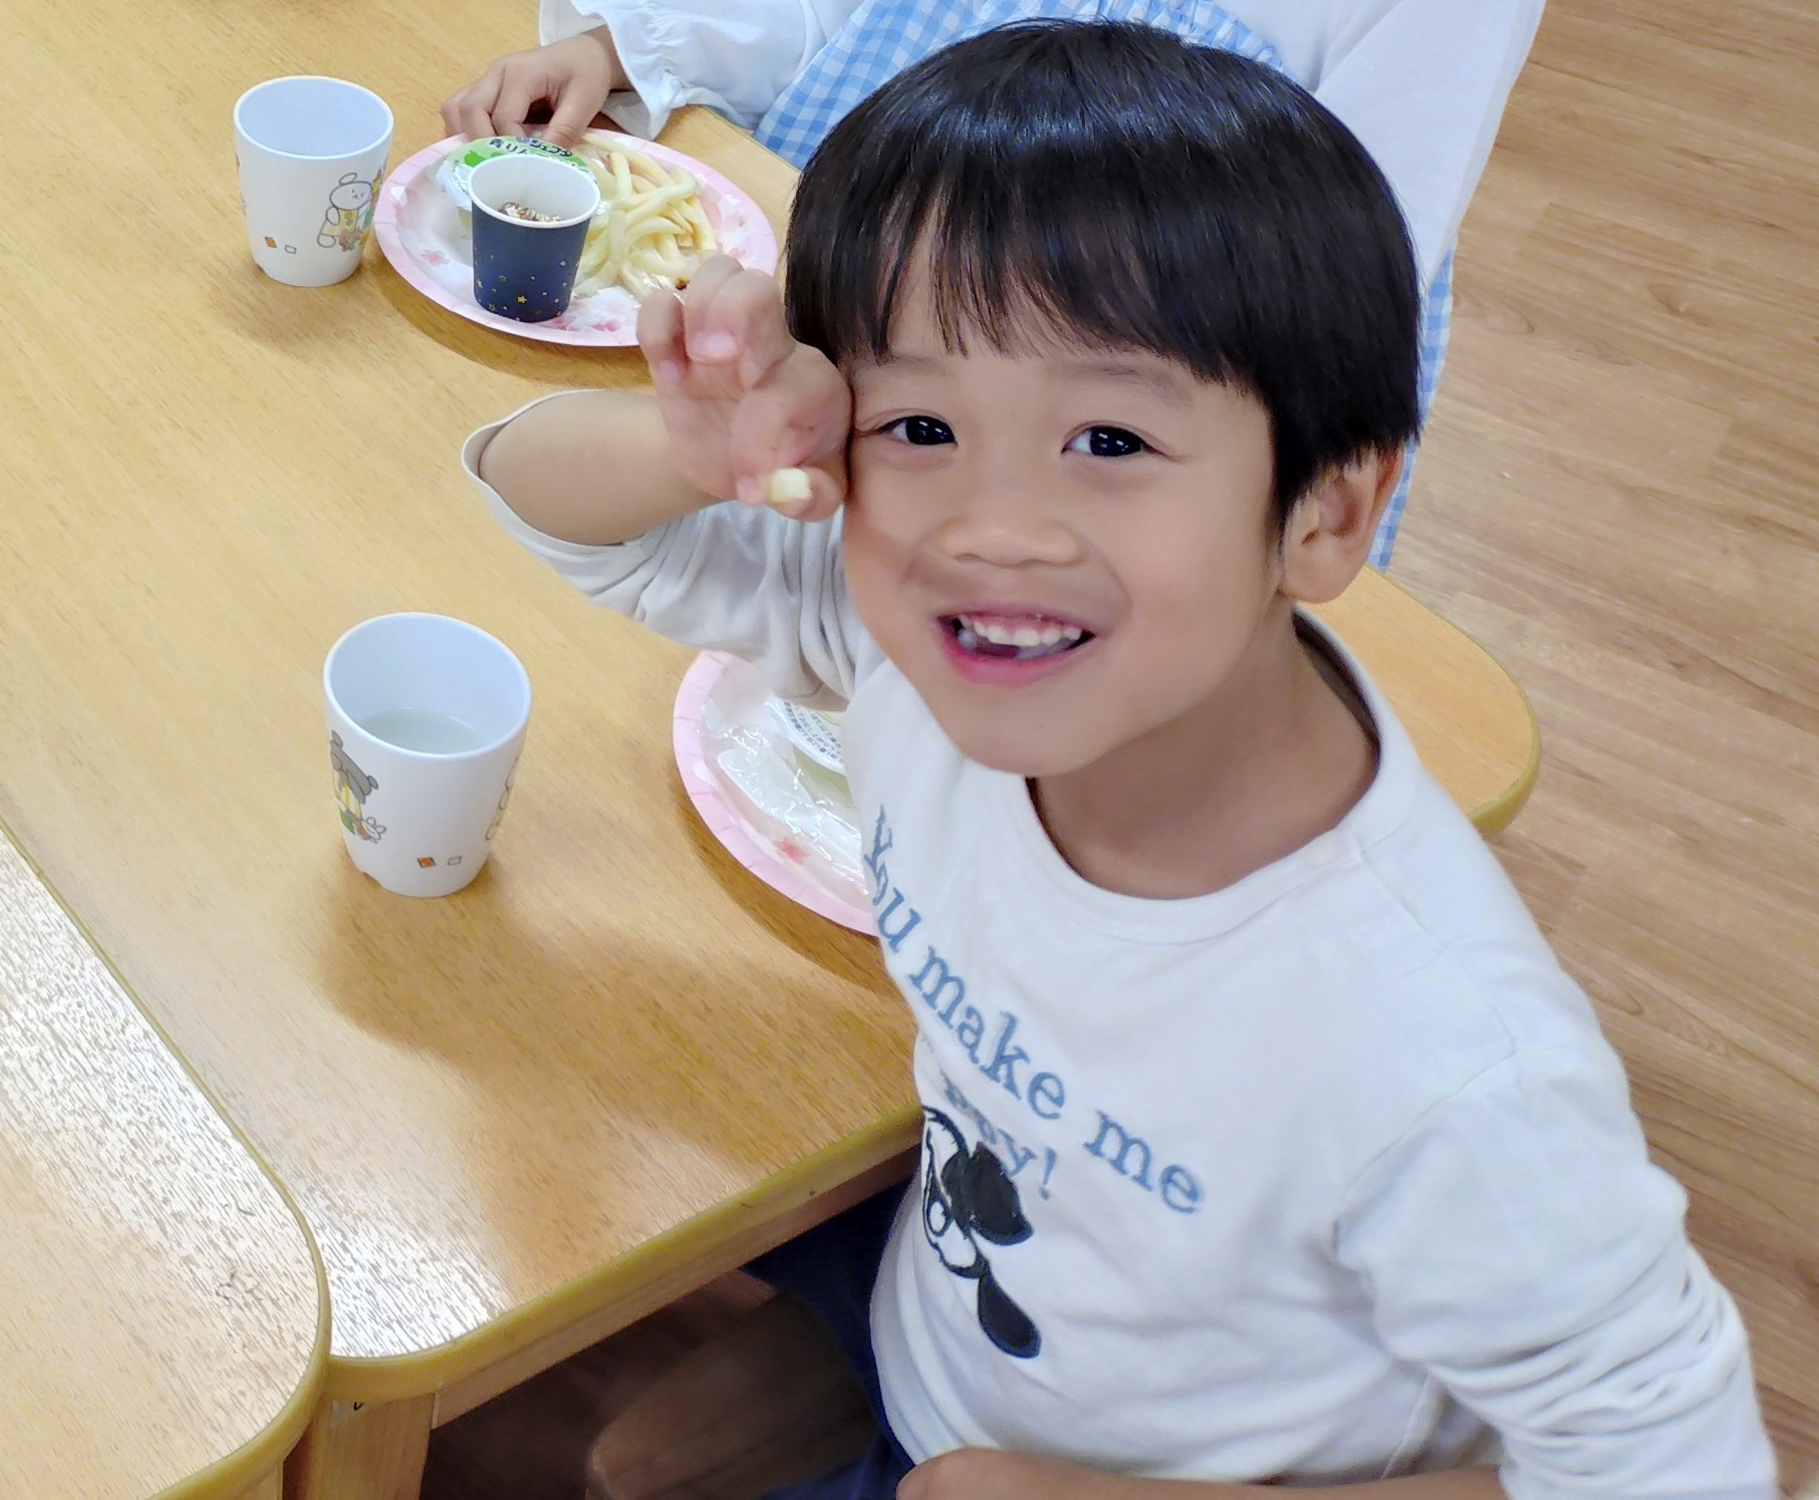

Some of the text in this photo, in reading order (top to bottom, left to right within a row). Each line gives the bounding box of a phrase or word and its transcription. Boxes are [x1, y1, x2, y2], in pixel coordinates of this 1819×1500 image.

[864, 803, 1203, 1215] You make me
